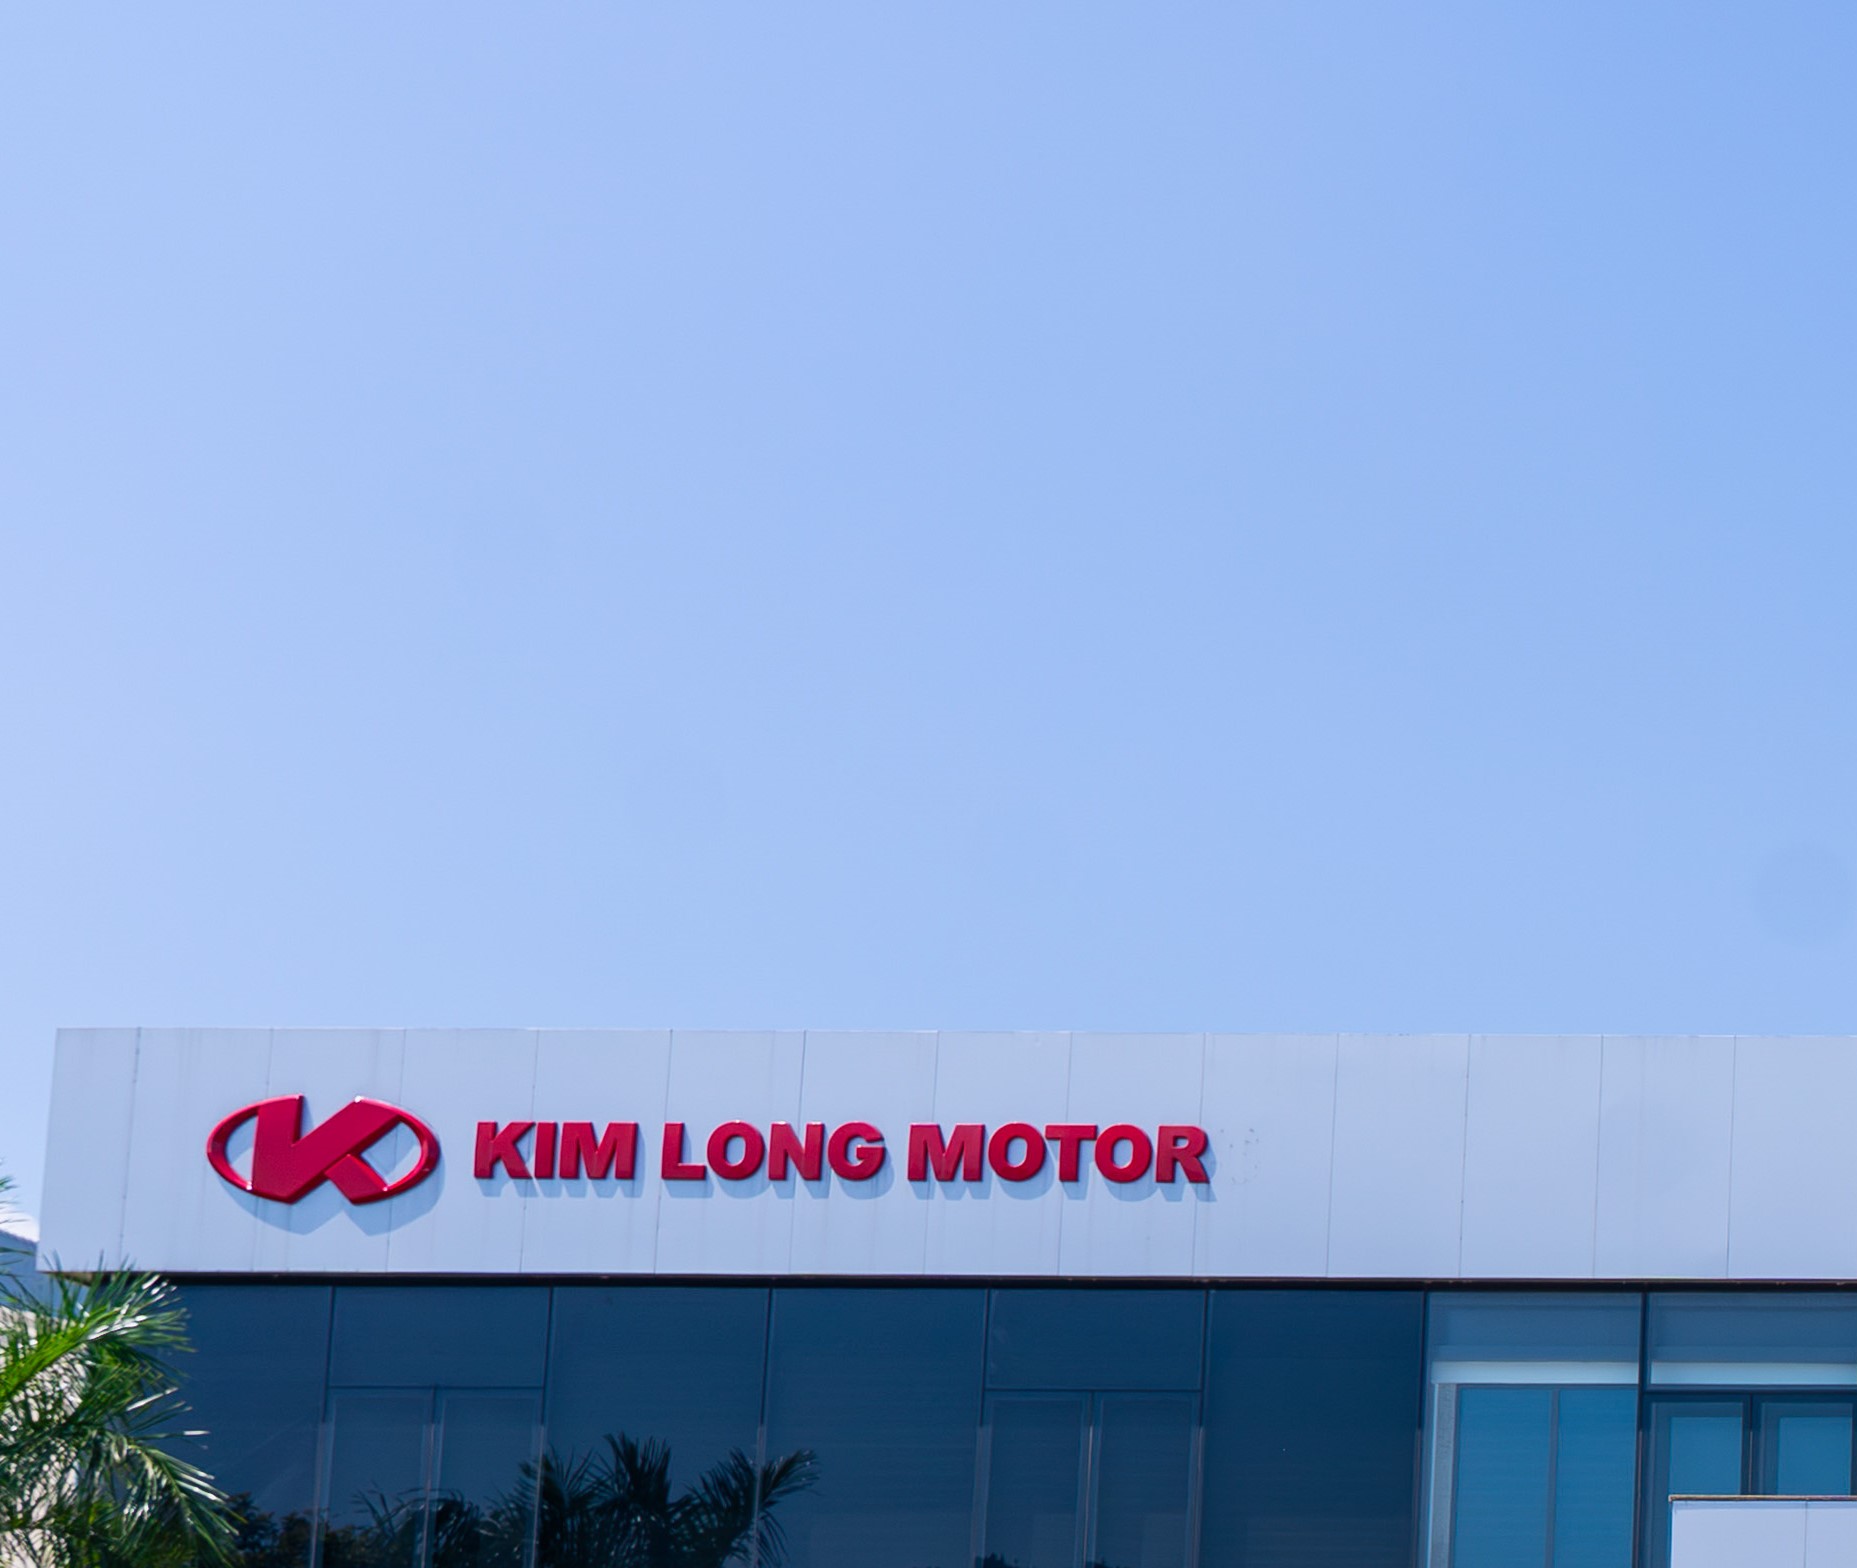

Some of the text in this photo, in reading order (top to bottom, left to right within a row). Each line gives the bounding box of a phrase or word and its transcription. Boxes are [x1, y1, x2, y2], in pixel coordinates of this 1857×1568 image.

[474, 1120, 1211, 1184] KIM LONG MOTOR
